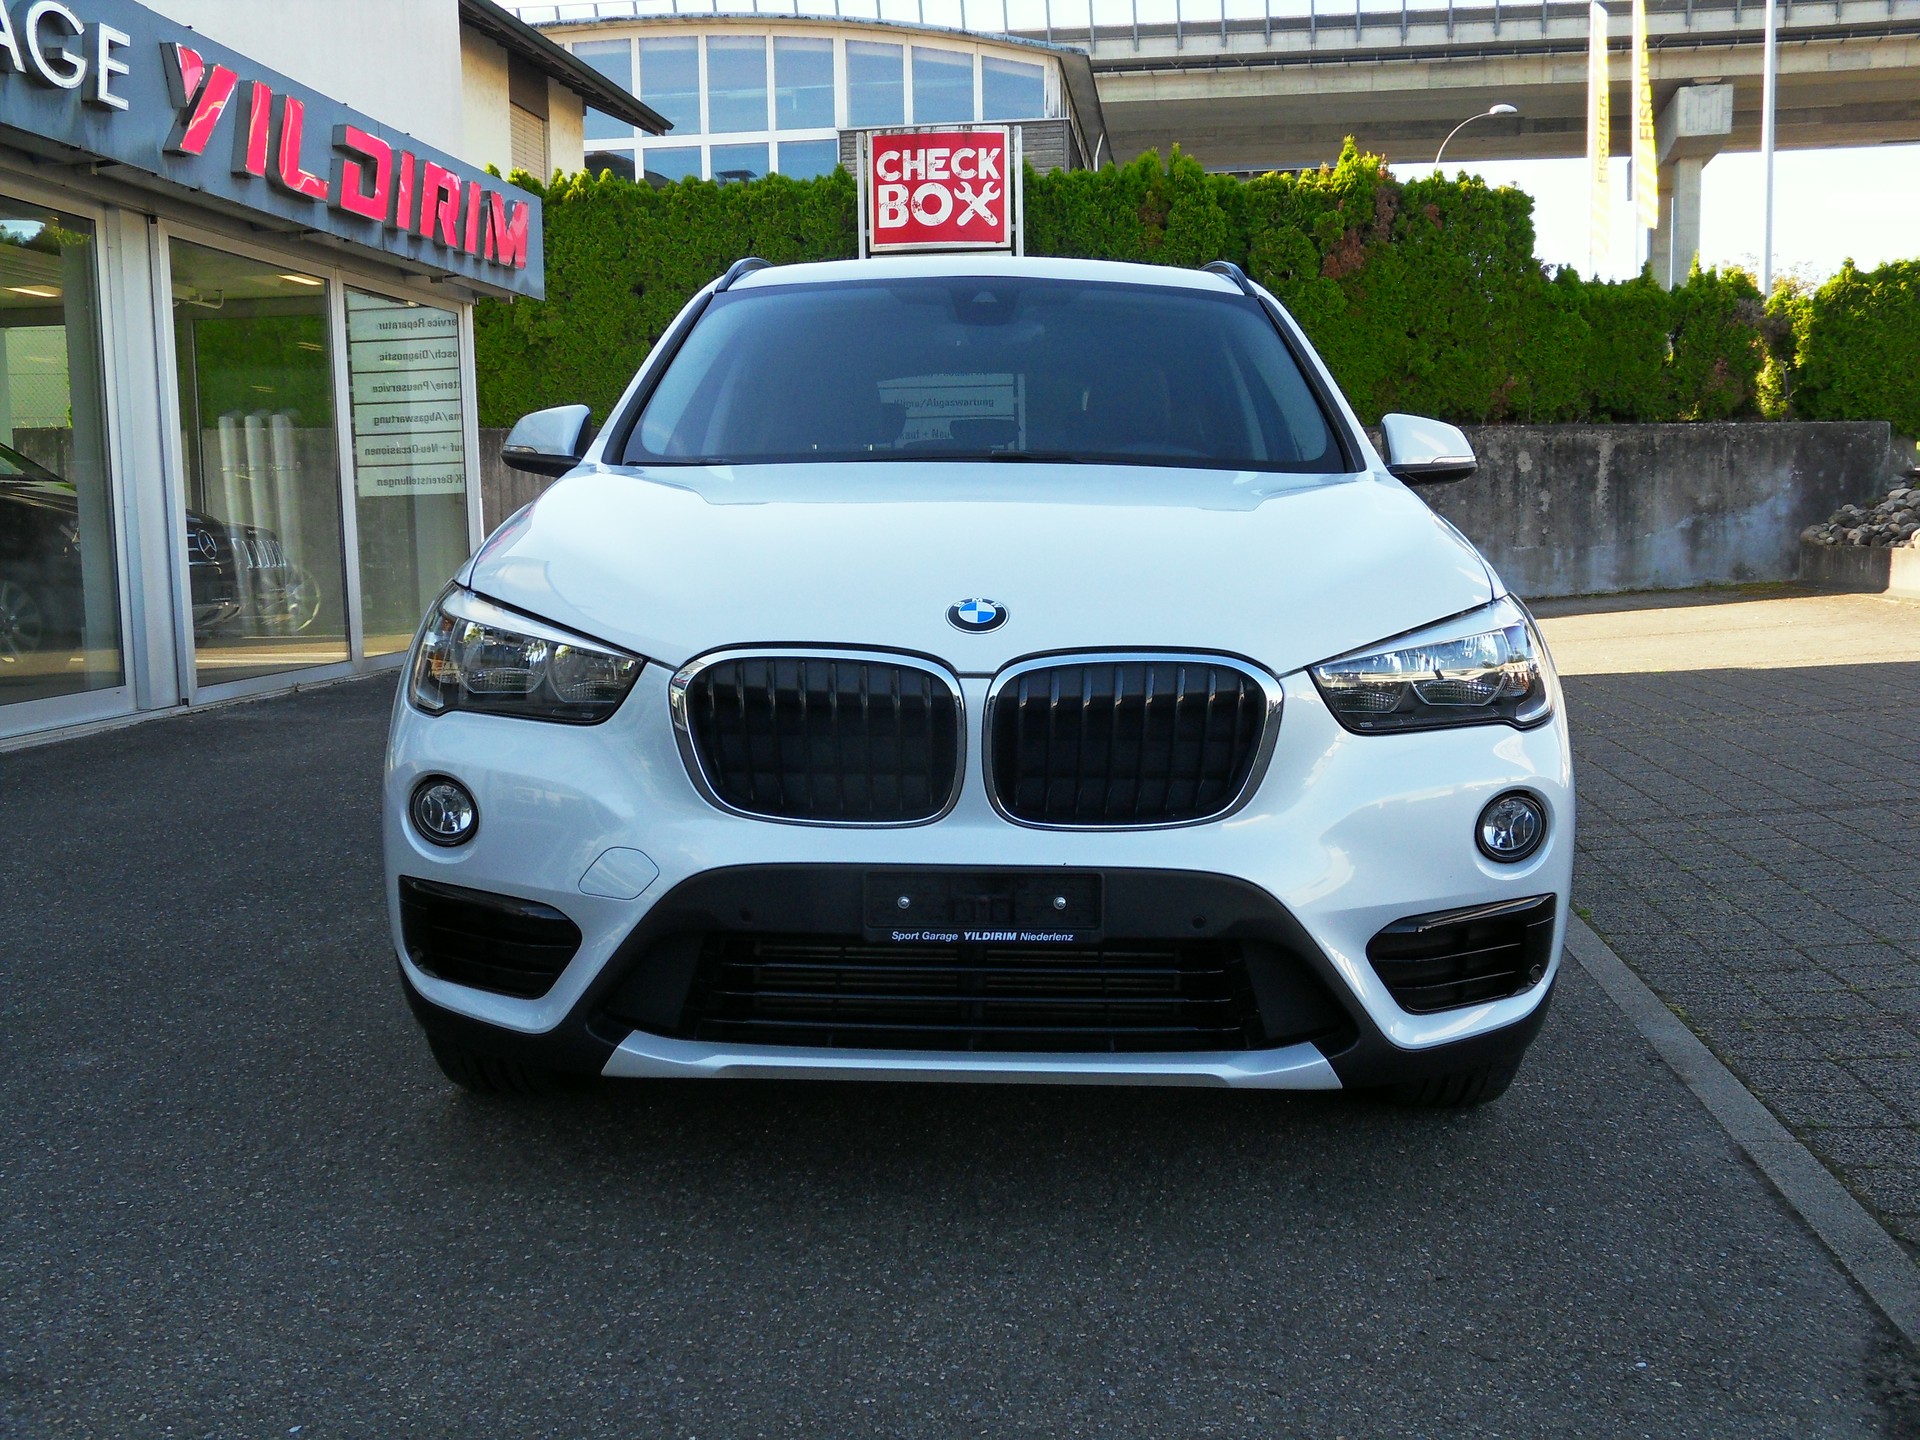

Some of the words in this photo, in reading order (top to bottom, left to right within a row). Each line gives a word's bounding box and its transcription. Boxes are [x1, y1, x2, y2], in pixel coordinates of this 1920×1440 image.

[164, 42, 529, 270] YILDIRIM
[876, 147, 1001, 182] CHECK
[878, 181, 1001, 229] BOX
[891, 931, 919, 942] Sport
[922, 932, 958, 942] Garage
[963, 931, 1017, 942] YILDIRIM
[1020, 932, 1074, 942] Niederlenz
